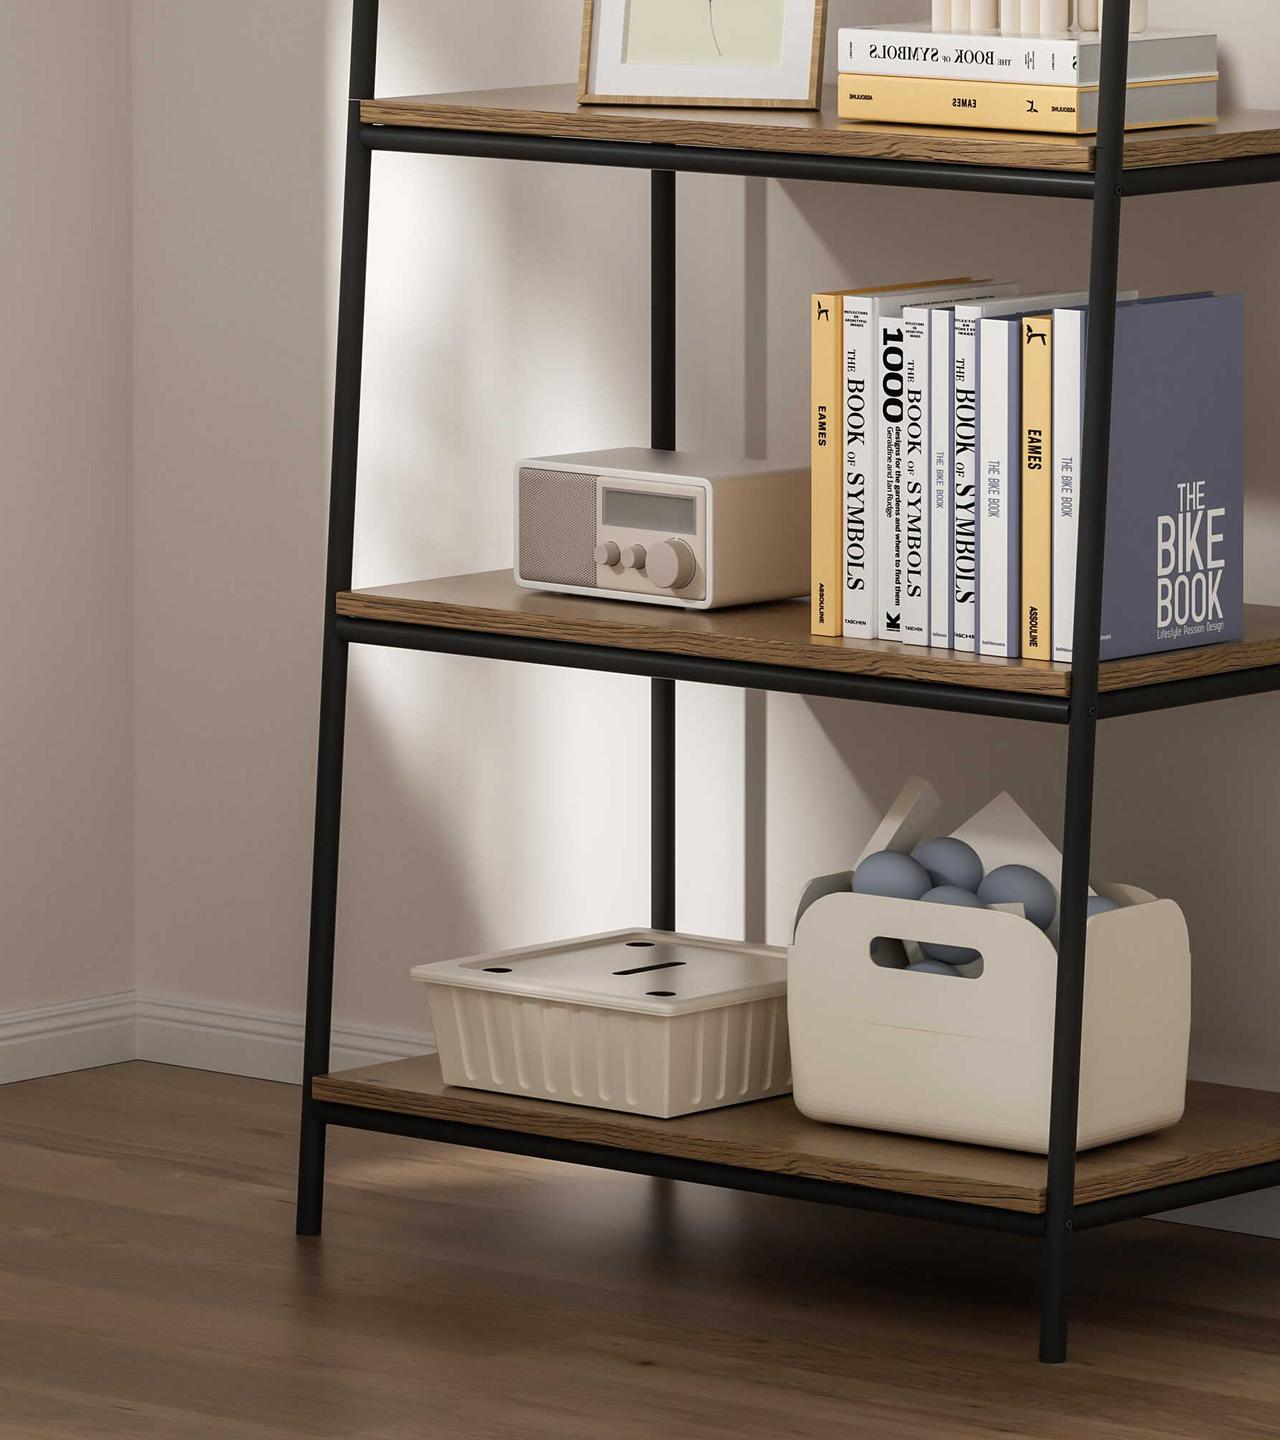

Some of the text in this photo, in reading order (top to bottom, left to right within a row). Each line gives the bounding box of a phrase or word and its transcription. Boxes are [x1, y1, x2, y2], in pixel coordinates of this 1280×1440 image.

[882, 328, 904, 423] 1000
[818, 406, 827, 447] EAMES
[907, 389, 922, 455] BOOK
[1028, 429, 1042, 470] EAMES
[847, 349, 865, 590] THE BOOK OF SYMBOLS
[907, 461, 914, 476] OF
[936, 452, 944, 509] THE BIKE BOOK
[956, 358, 975, 603] THE BOOK OF SYMBOLS
[988, 460, 1000, 518] THE BIKE BOOK
[1061, 457, 1072, 518] THE BIKE BOOK
[1177, 481, 1205, 512] THE
[894, 485, 902, 516] gardens
[895, 560, 901, 568] to
[907, 481, 922, 597] SYMBOLS
[1157, 508, 1225, 577] BIKE
[1029, 606, 1038, 648] ASSOULINE
[1157, 569, 1223, 628] BOOK
[1157, 621, 1224, 640] Lifestyle Passion Design
